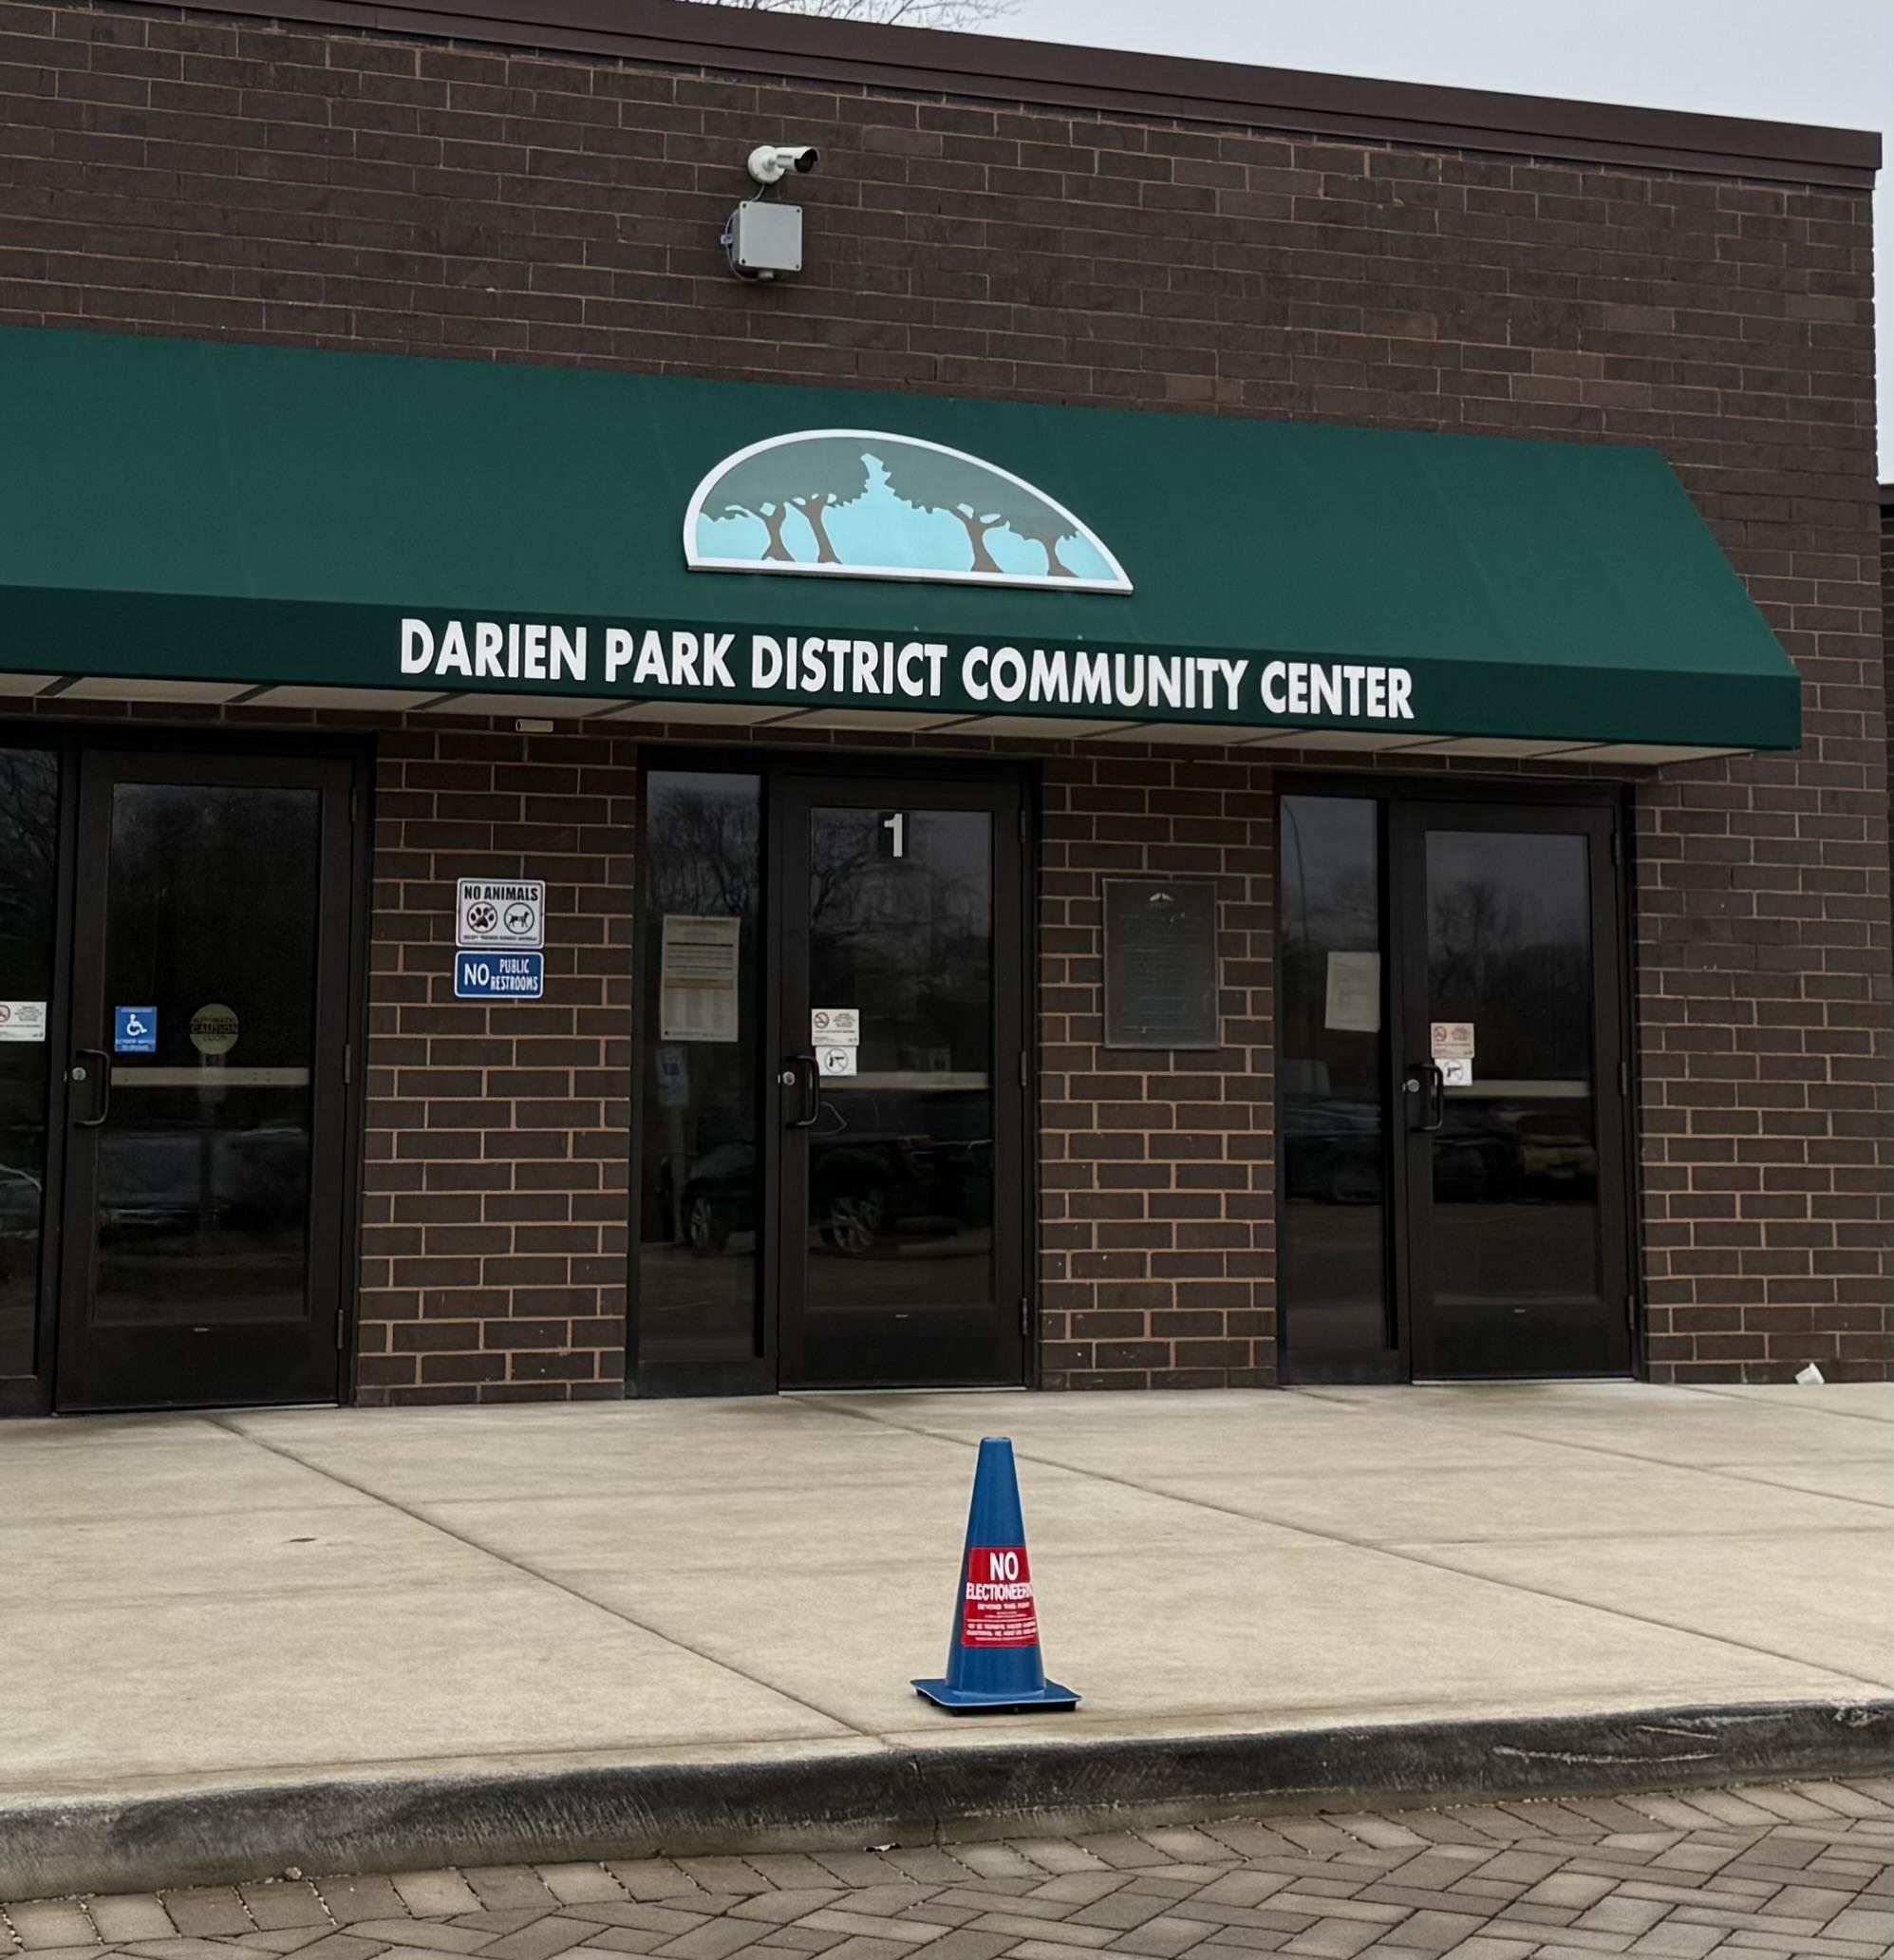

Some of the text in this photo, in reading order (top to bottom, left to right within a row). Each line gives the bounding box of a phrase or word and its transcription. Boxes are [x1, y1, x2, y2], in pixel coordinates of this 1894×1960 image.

[401, 617, 1416, 720] DARIEN PARK DISTRICT COMMUNITY CENTER
[883, 813, 904, 858] 1
[464, 885, 538, 901] NO ANIMALS
[464, 964, 490, 986] NO
[499, 958, 530, 974] PUBLIC
[490, 975, 538, 991] RESTROOMS
[989, 1551, 1020, 1581] NO
